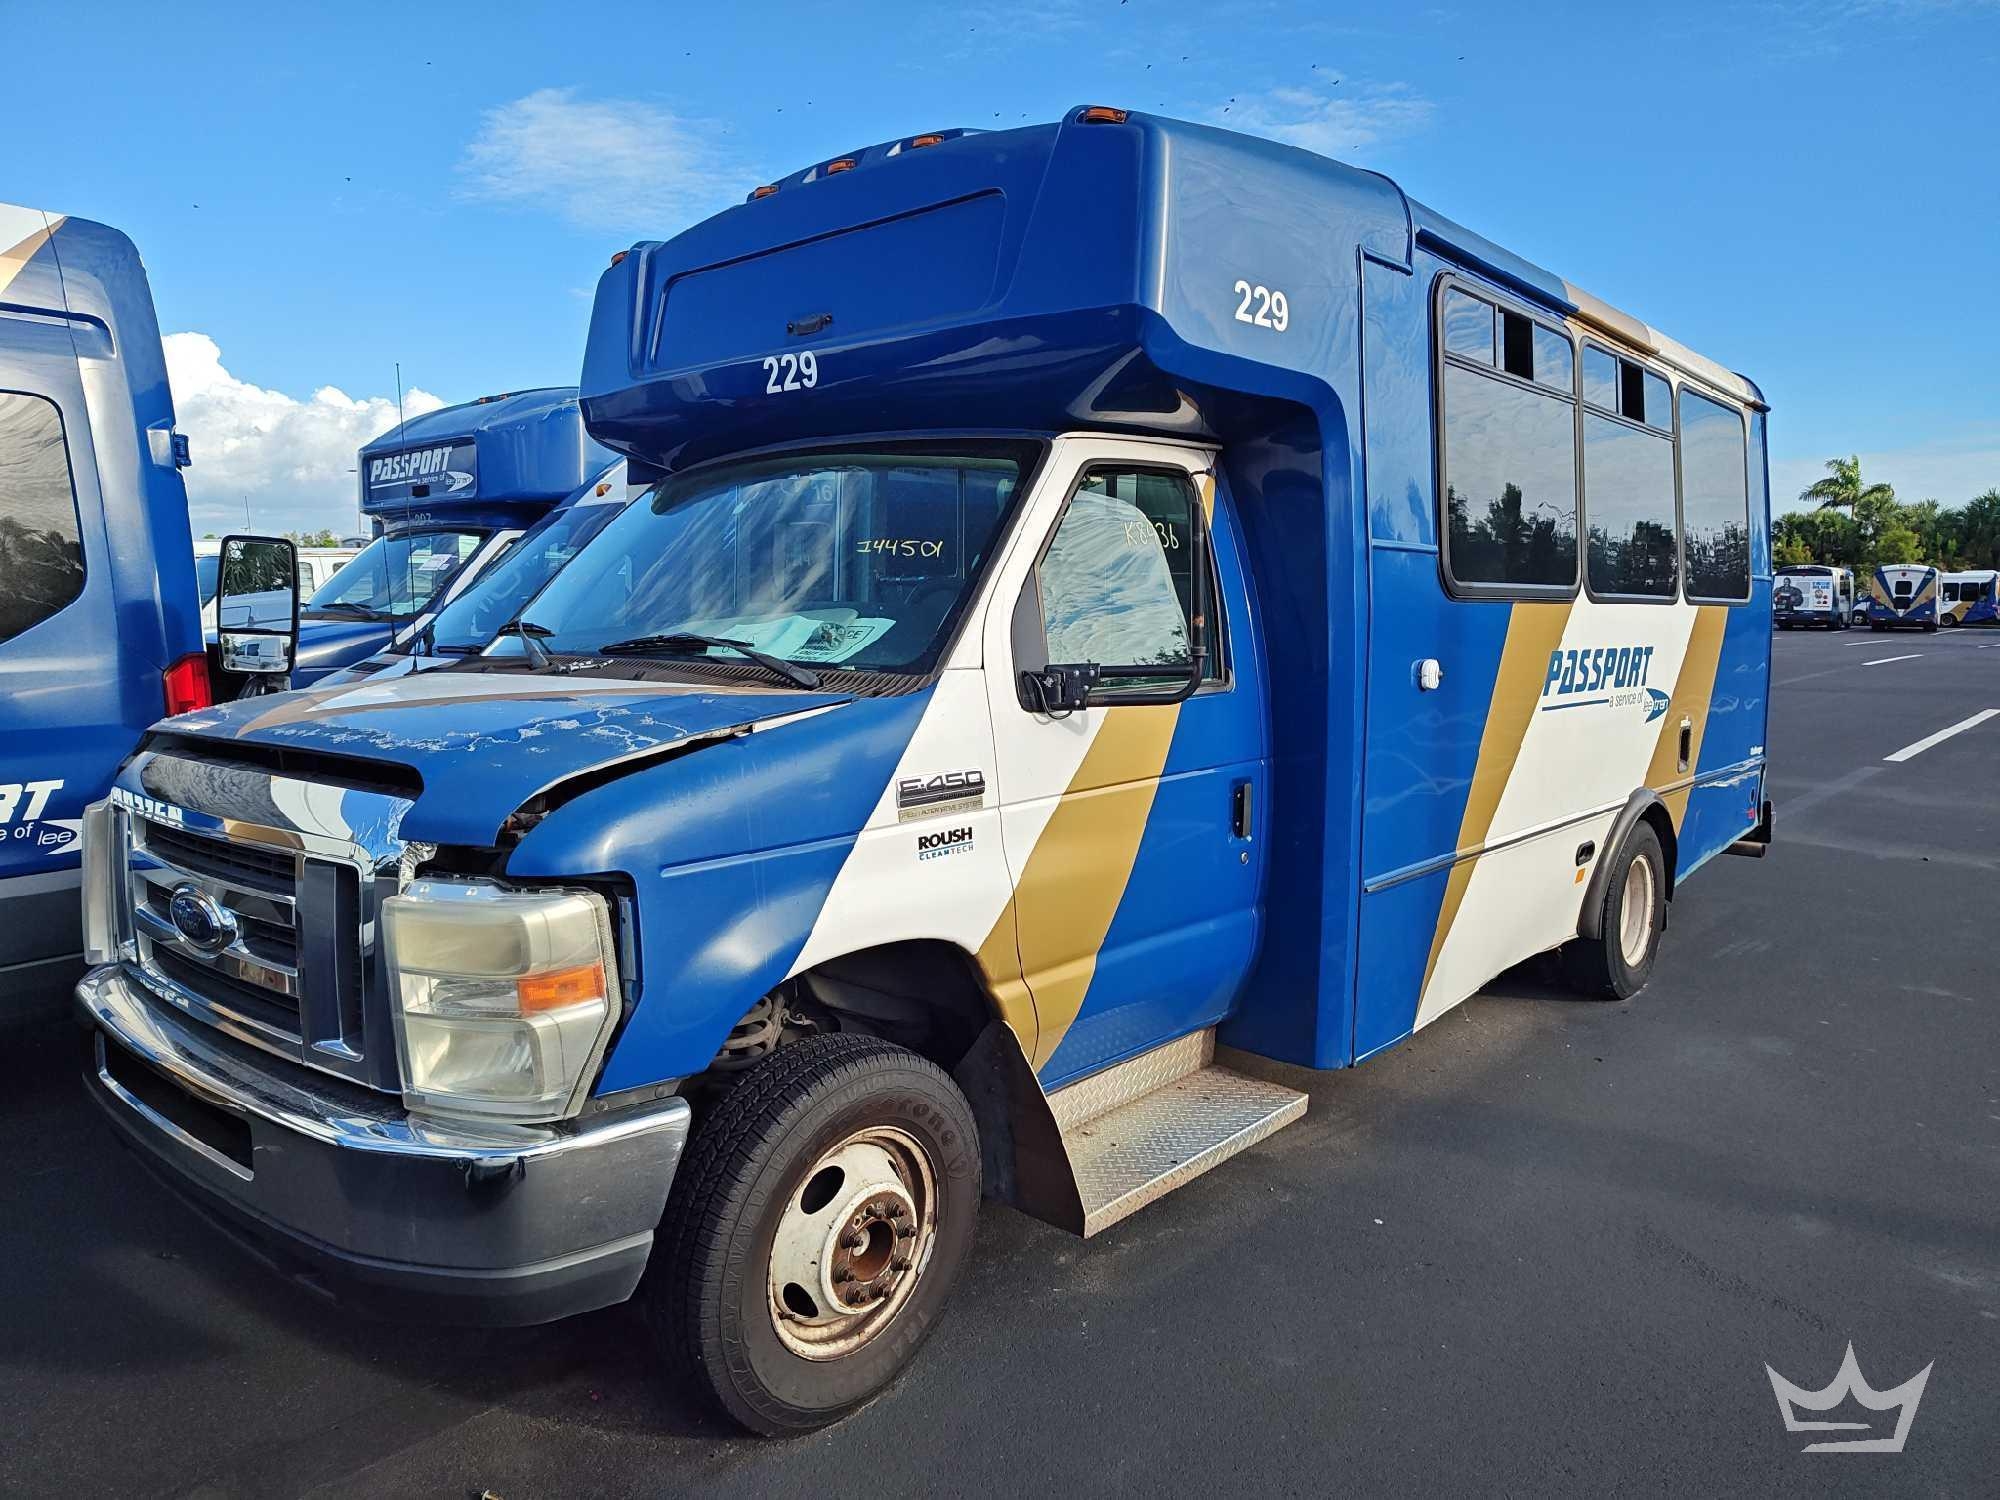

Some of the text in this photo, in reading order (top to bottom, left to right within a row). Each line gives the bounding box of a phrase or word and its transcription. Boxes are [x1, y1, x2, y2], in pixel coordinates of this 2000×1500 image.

[1234, 280, 1289, 332] 229
[763, 350, 818, 395] 229
[370, 446, 453, 481] PASSPORT
[1542, 646, 1654, 697] PASSPORT
[14, 821, 35, 840] of
[918, 826, 973, 851] ROUSH
